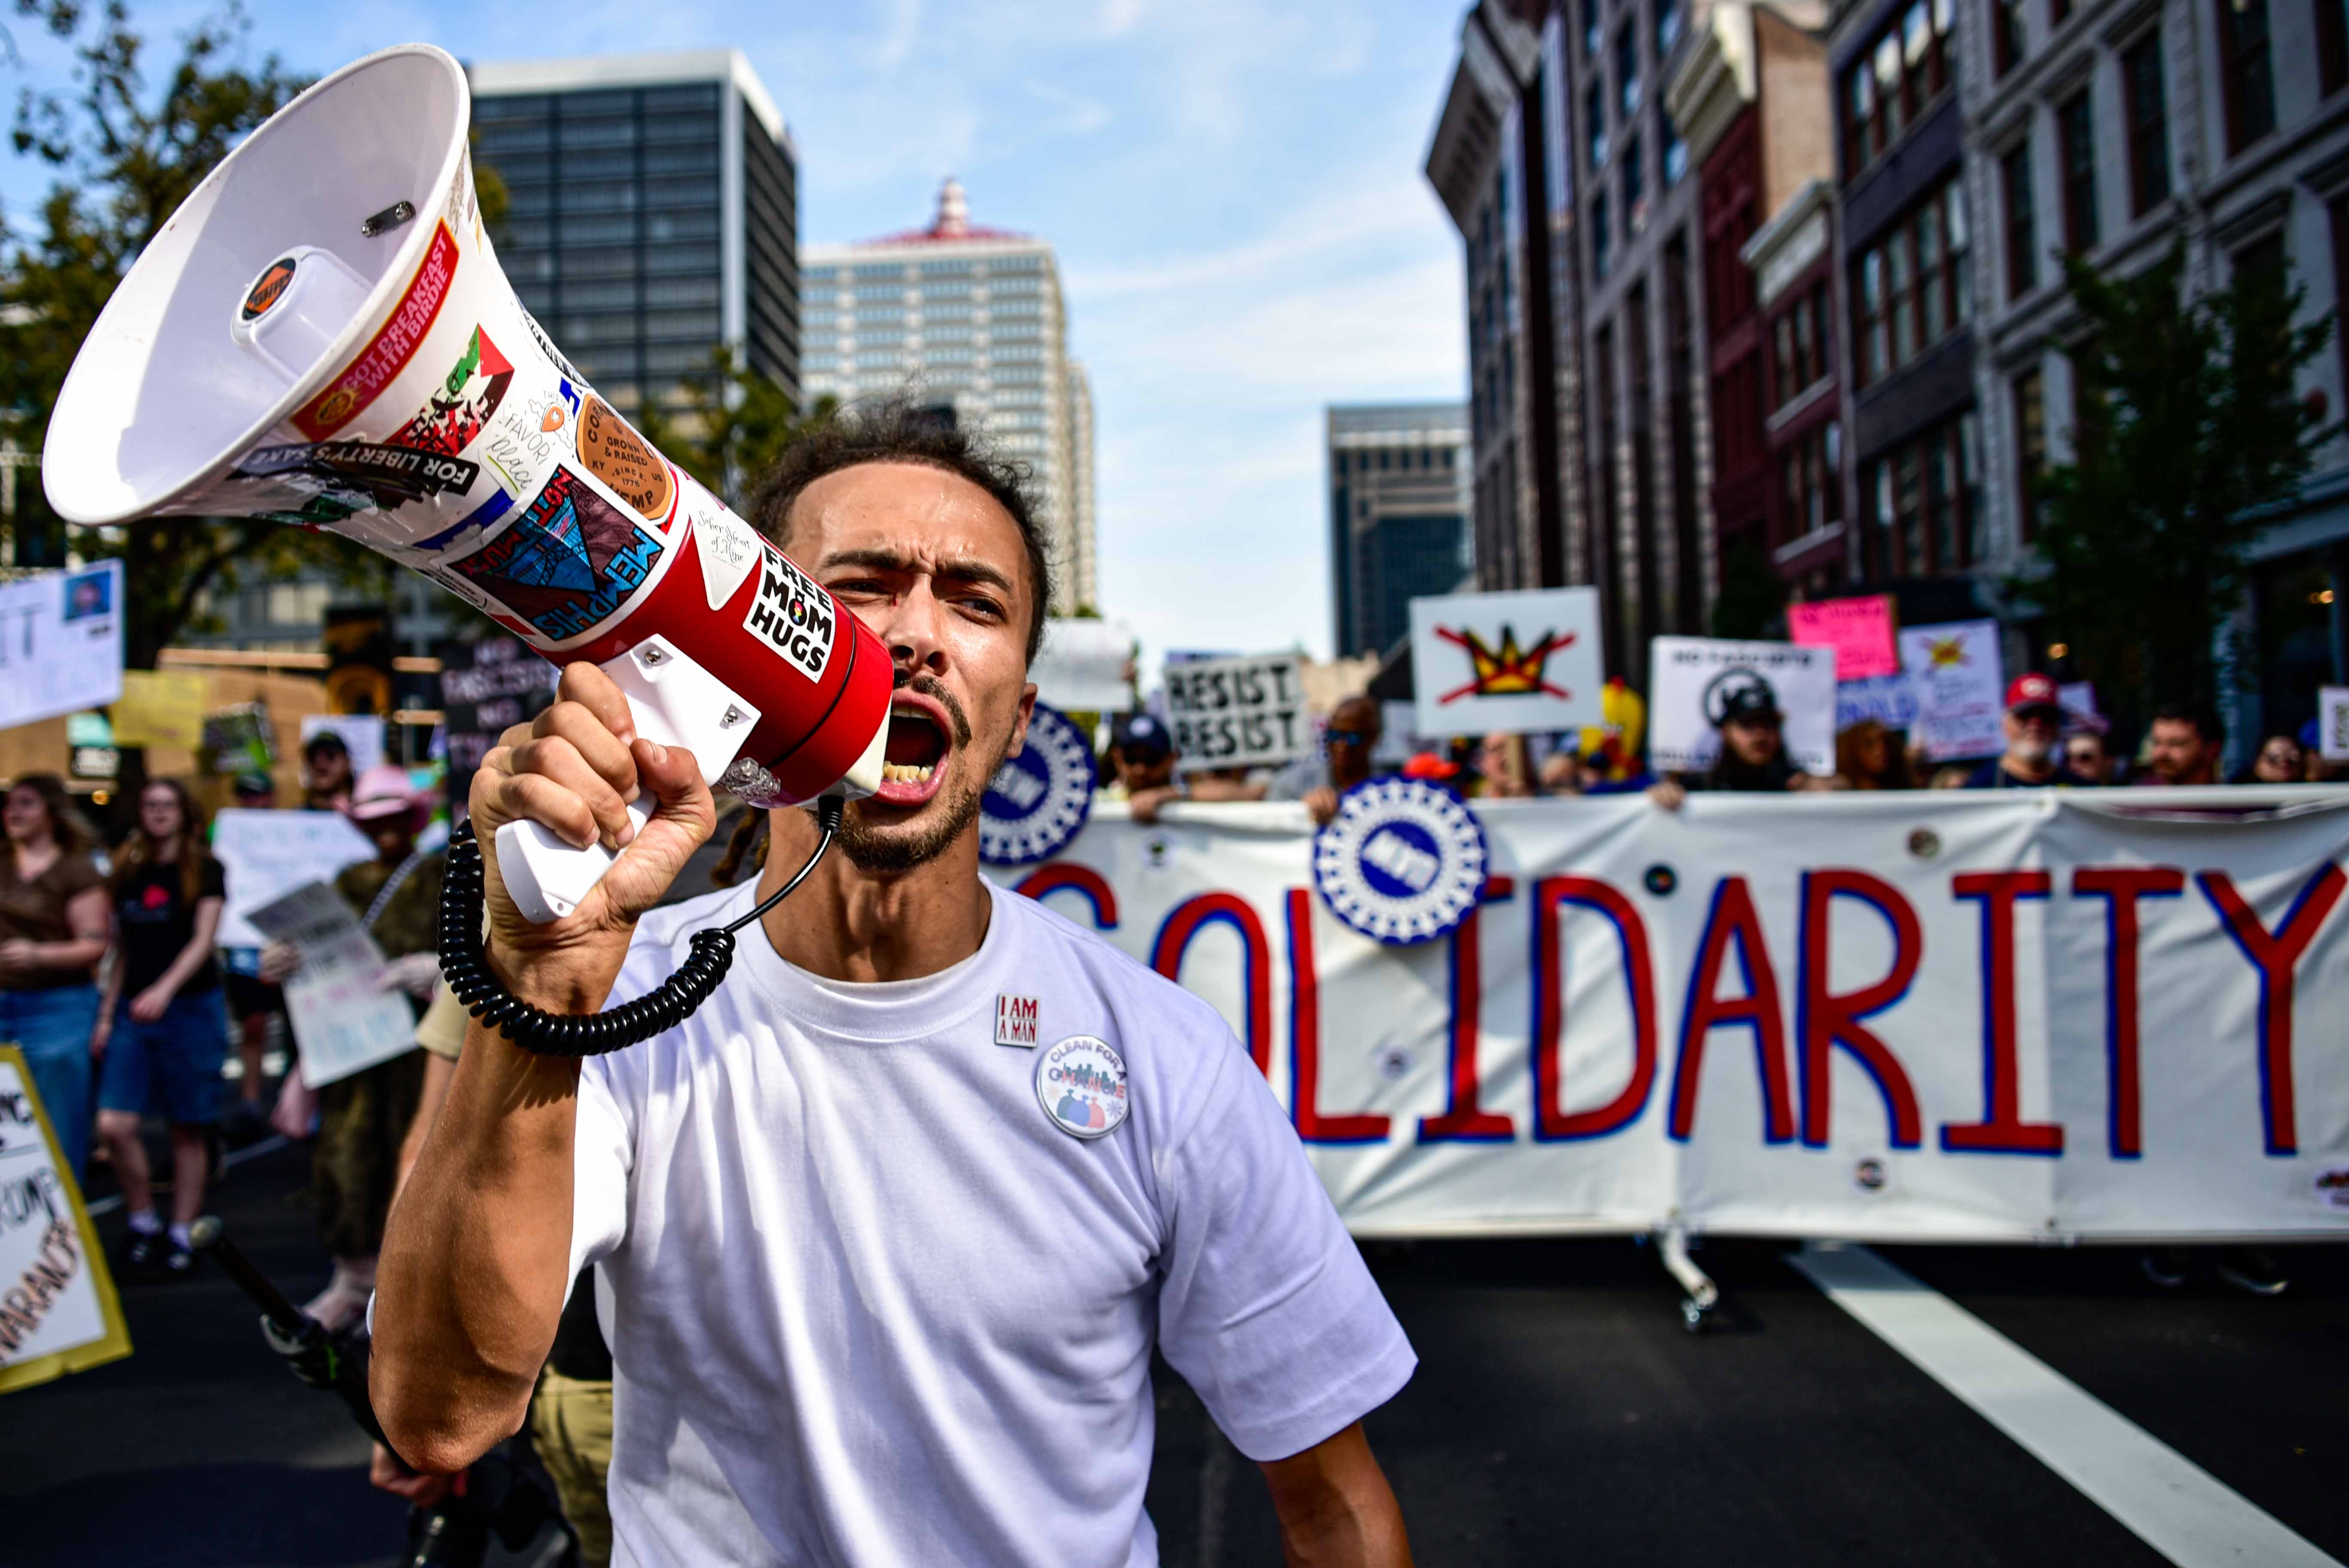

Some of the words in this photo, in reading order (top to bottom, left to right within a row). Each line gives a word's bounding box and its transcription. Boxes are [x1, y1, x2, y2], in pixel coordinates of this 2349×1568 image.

[343, 351, 378, 389] GOT
[377, 232, 447, 356] BREAKFAST
[364, 337, 411, 389] WITH
[407, 266, 449, 339] BIRDIE
[313, 446, 421, 471] LIBERTY'S
[605, 446, 612, 457] &
[614, 449, 648, 466] RAISED
[606, 436, 641, 454] GROWN
[423, 458, 471, 486] FOR
[592, 459, 605, 471] KY
[651, 472, 663, 482] US
[532, 466, 573, 527] NOT
[711, 536, 720, 553] of
[532, 526, 663, 640] MEMPHIS
[763, 544, 832, 614] FREE
[762, 569, 832, 647] MOM
[751, 601, 826, 672] HUGS
[1171, 664, 1289, 711] RESIST
[1177, 711, 1295, 757] RESIST
[1000, 996, 1006, 1017] I
[1010, 997, 1038, 1019] AM
[998, 1018, 1007, 1040] A
[1011, 1019, 1036, 1043] MAN
[1050, 1040, 1093, 1063] CLEAN
[1096, 1044, 1120, 1069] FOR
[1117, 1071, 1128, 1082] A
[1048, 1066, 1126, 1099] CHANGE
